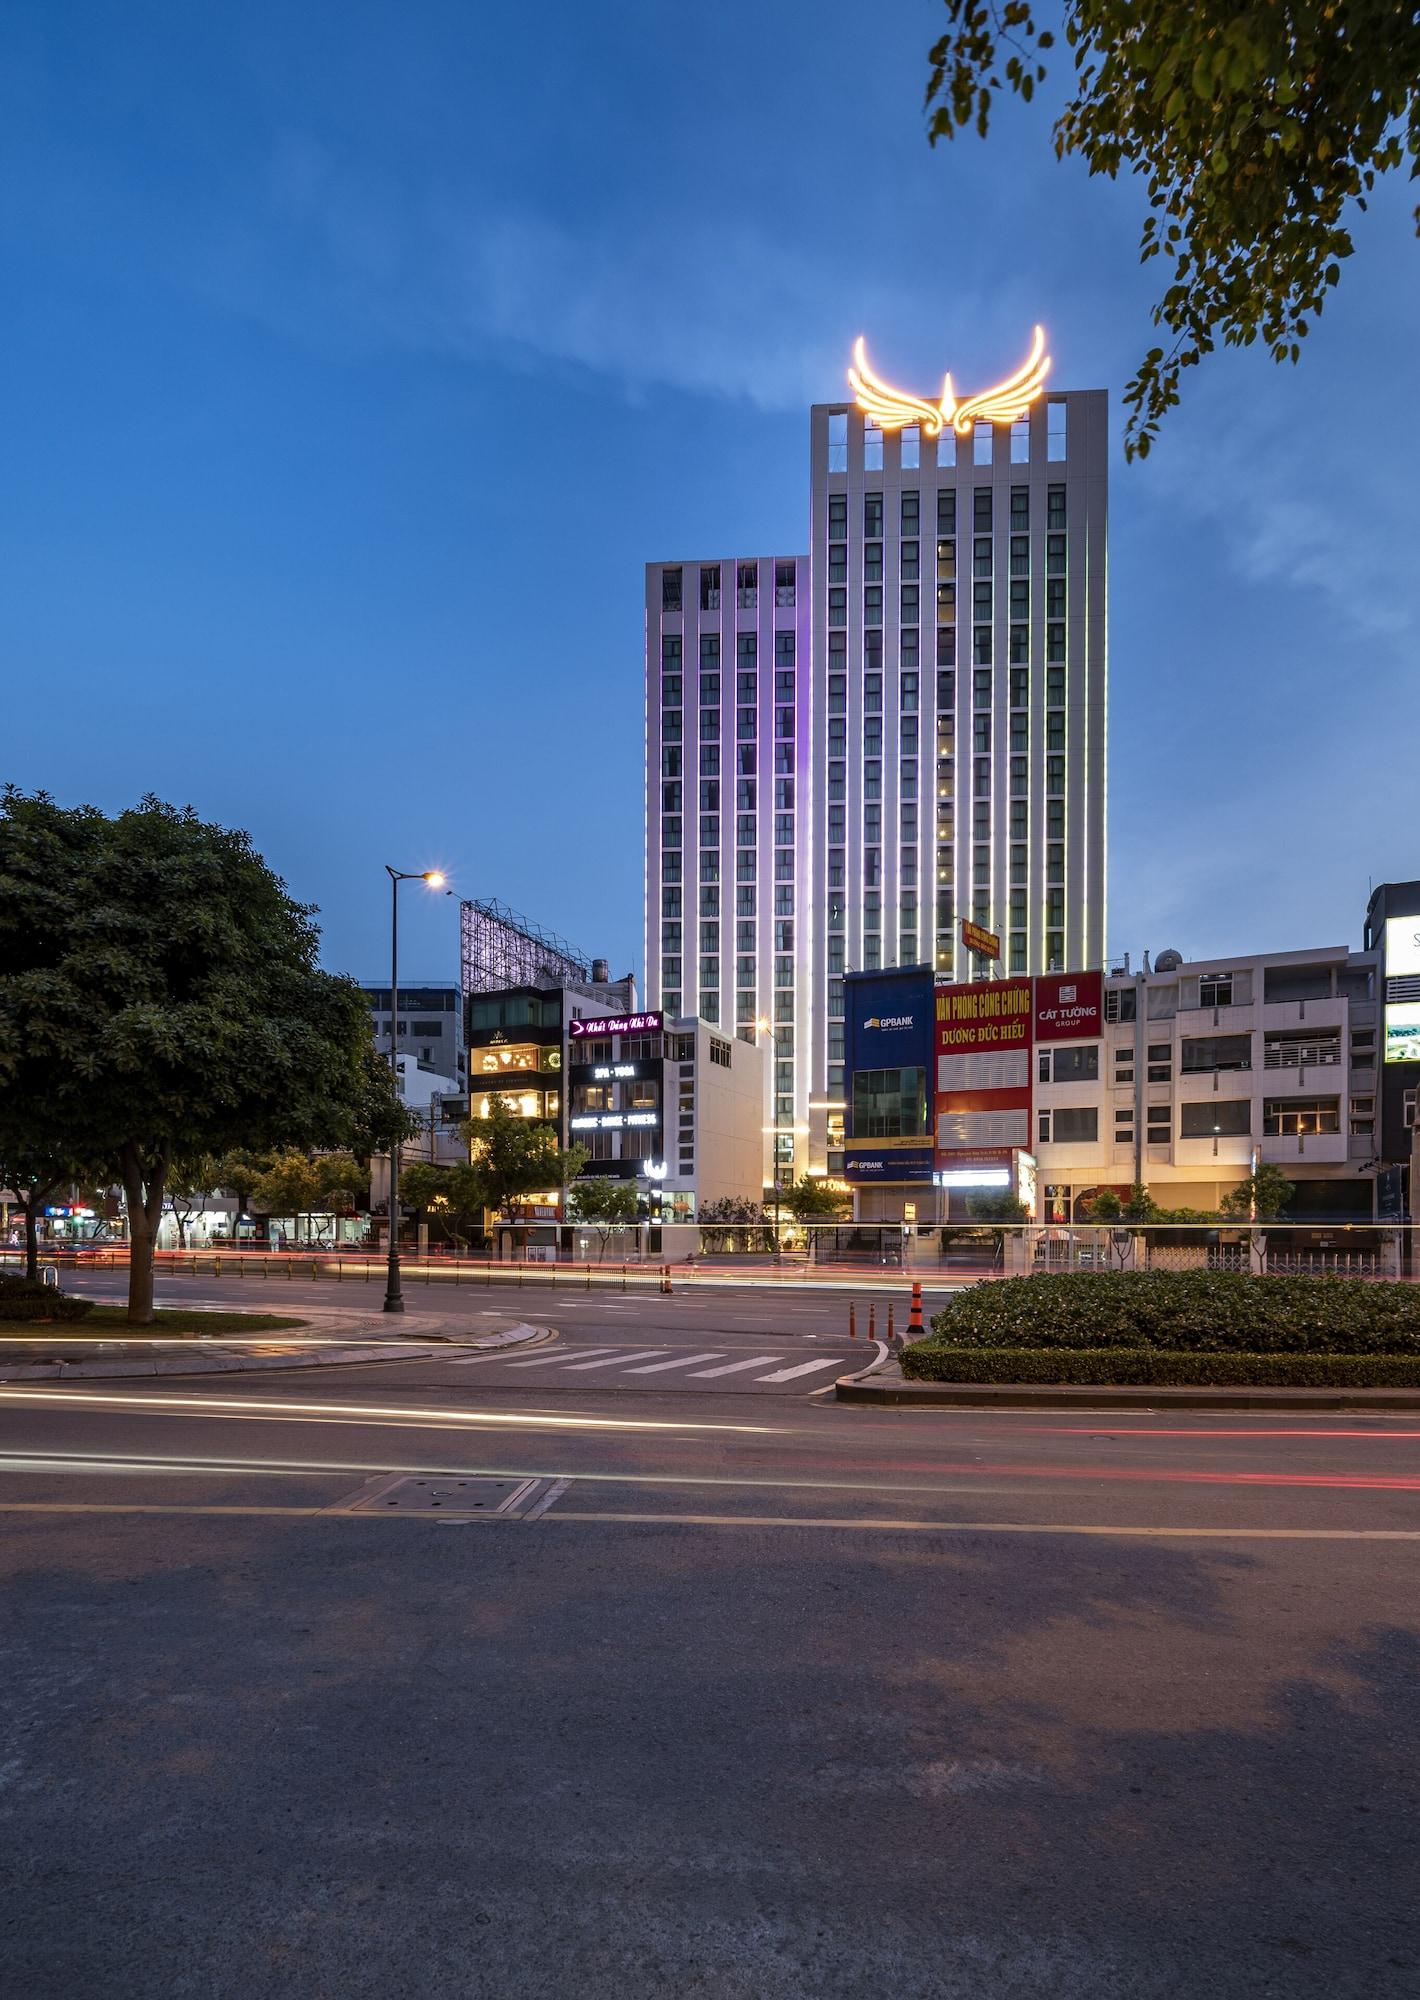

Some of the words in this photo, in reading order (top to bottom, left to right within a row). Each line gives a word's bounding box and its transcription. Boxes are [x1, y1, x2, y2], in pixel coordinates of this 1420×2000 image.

[952, 991, 978, 1020] PHÒNG
[979, 988, 1001, 1018] CÔNG
[1002, 985, 1030, 1016] CHỨNG
[1039, 1009, 1058, 1020] CÁT
[1060, 1006, 1097, 1019] TƯỜNG
[881, 1016, 914, 1028] GPBANK
[1056, 1020, 1081, 1028] GROUP
[942, 1028, 976, 1045] DƯƠNG
[978, 1023, 999, 1042] ĐỨC
[1000, 1018, 1025, 1040] HIẾU
[859, 1161, 884, 1170] GPBANK
